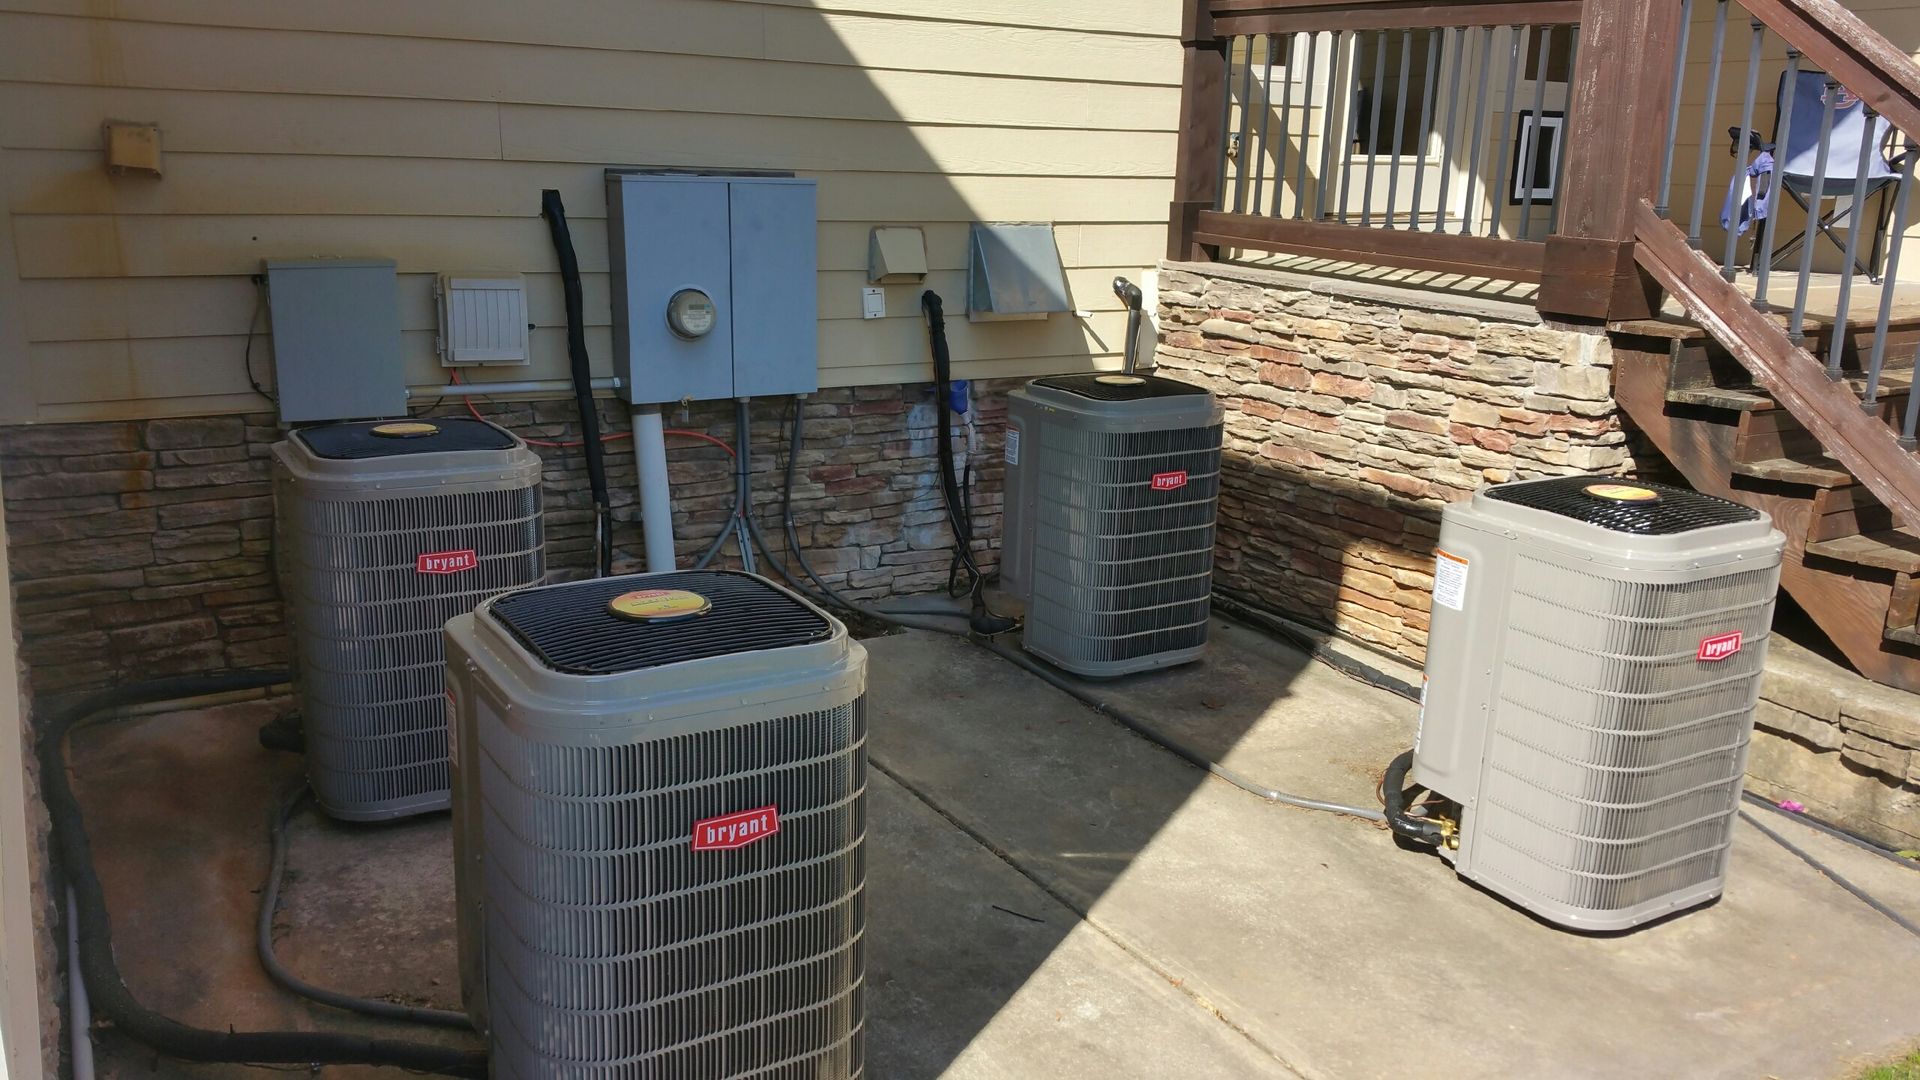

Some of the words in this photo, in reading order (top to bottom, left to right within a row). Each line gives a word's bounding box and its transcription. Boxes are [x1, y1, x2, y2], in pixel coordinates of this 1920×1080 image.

[1157, 475, 1182, 487] bryant
[426, 554, 470, 570] bryant
[707, 814, 768, 844] bryant
